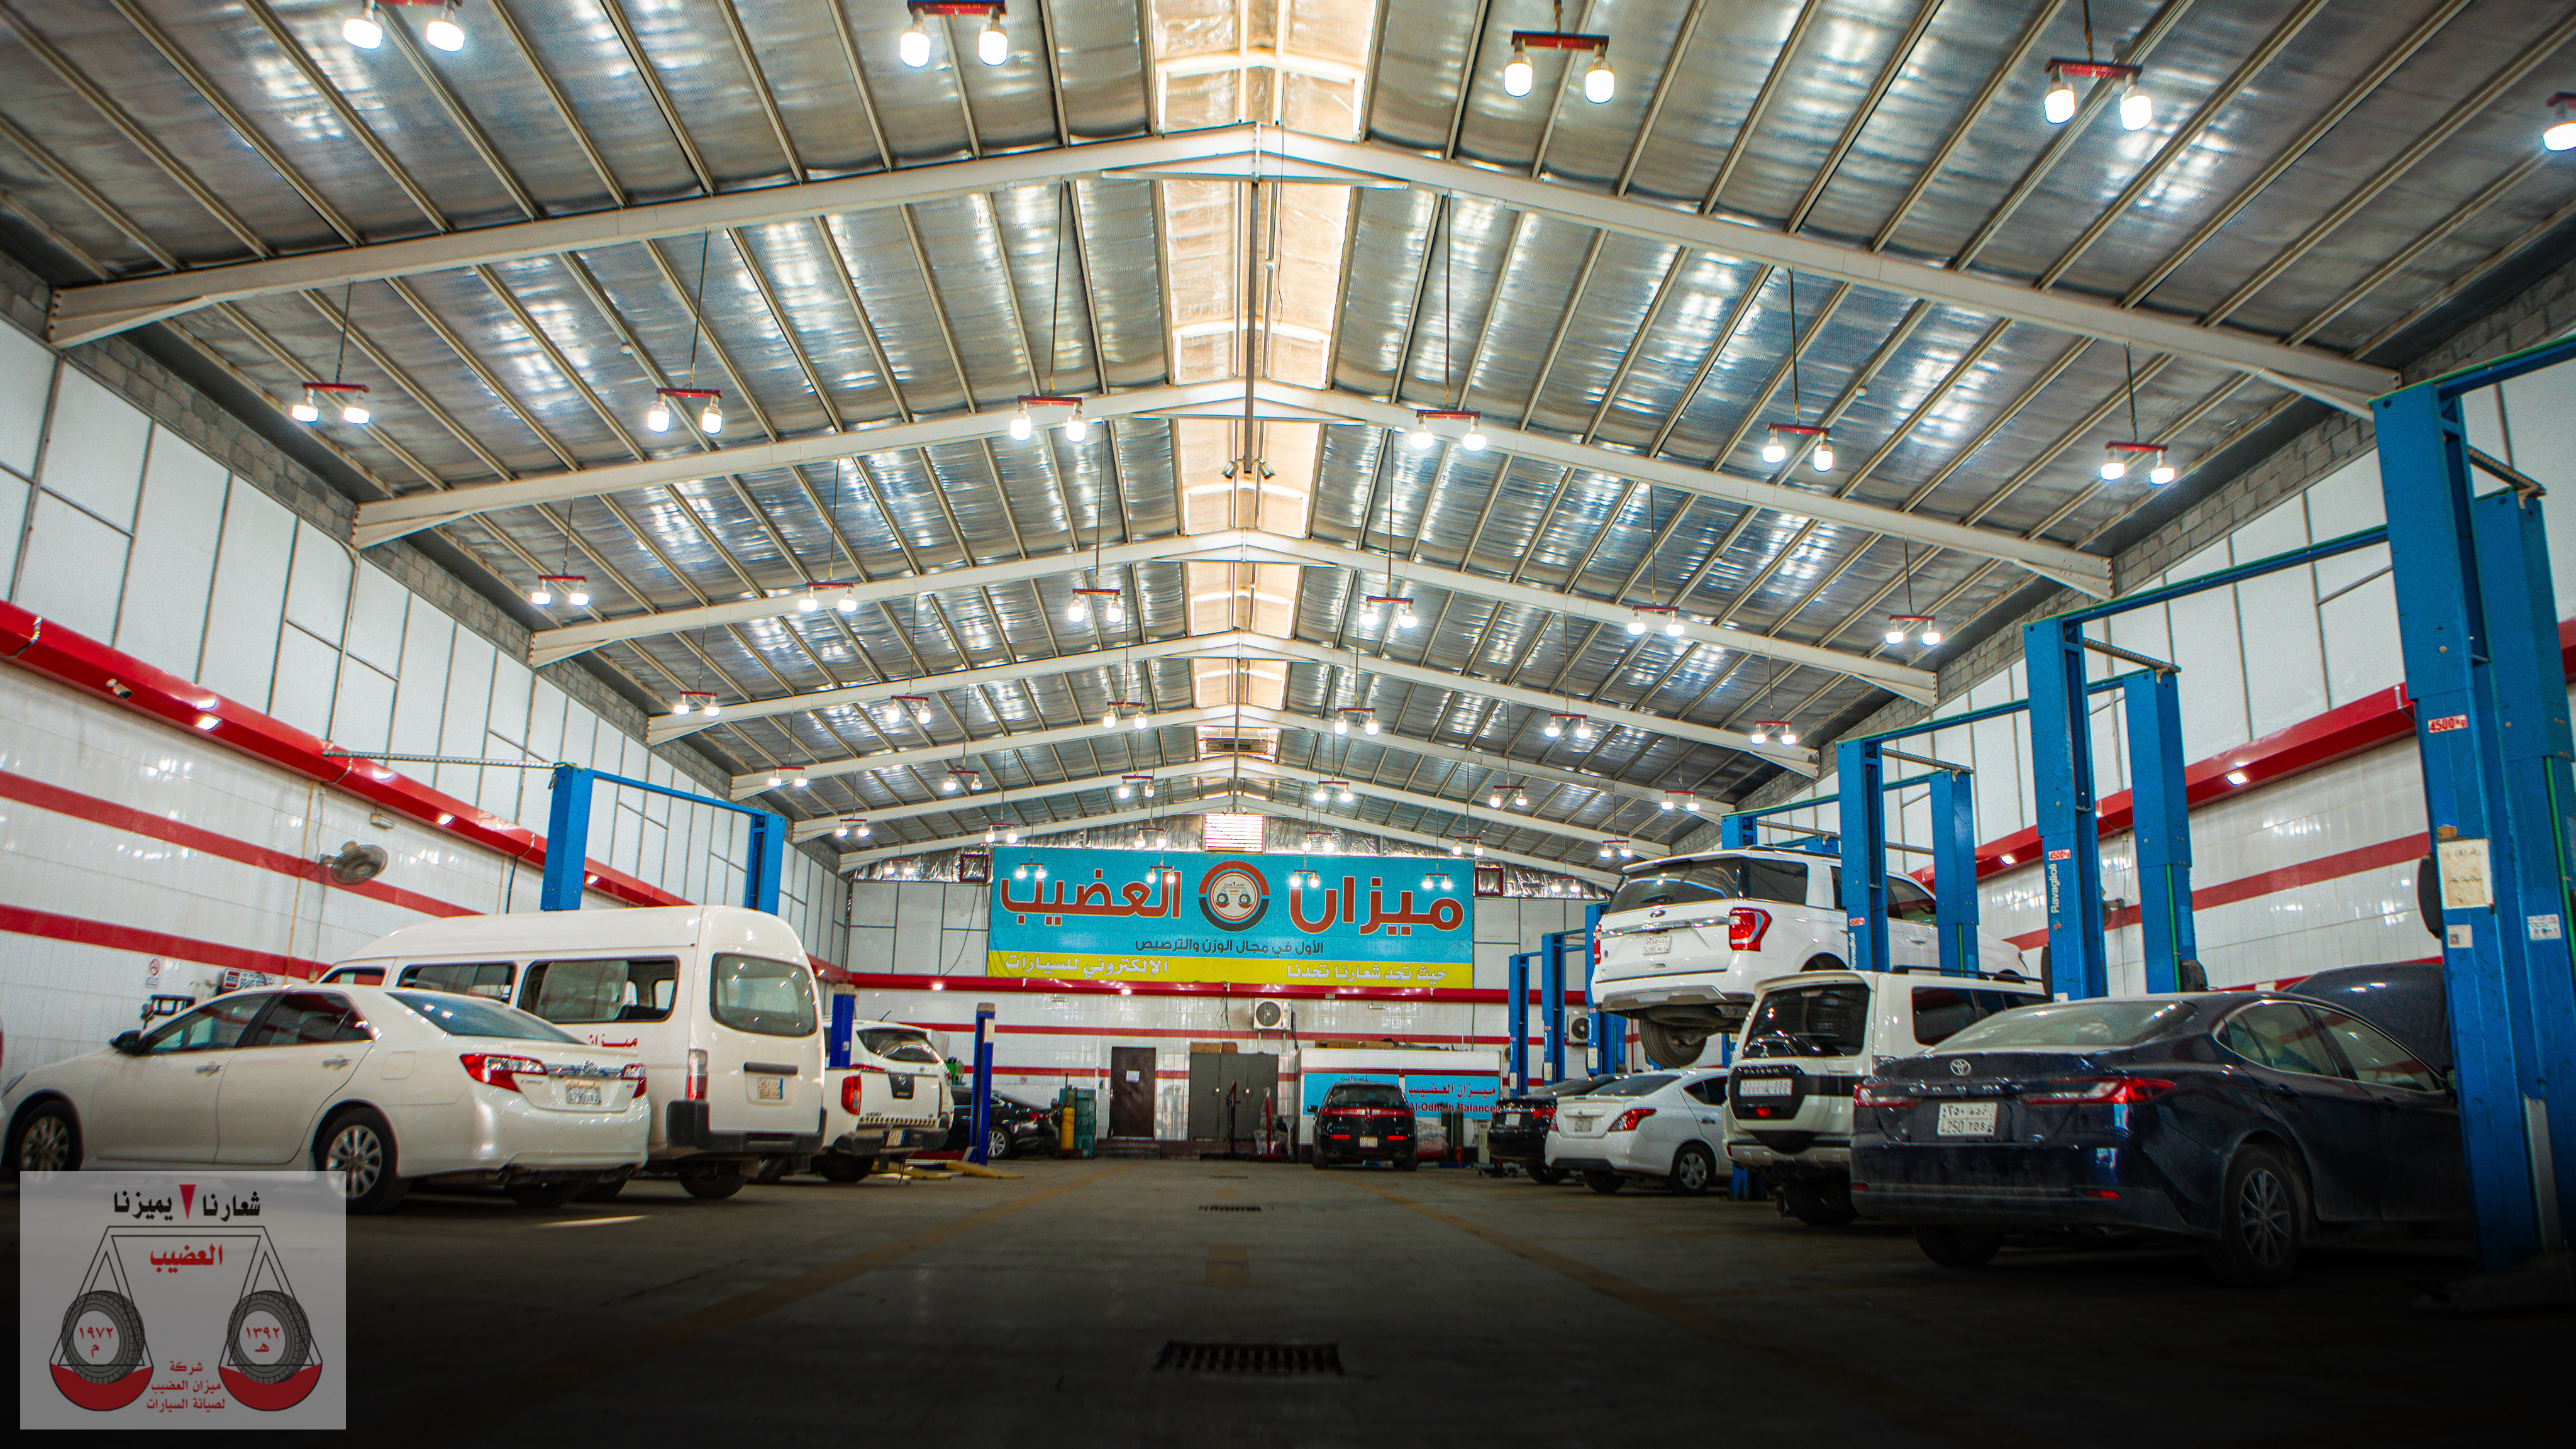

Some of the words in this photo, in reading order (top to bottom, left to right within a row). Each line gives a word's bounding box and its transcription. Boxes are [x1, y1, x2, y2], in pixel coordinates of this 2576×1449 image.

[1001, 869, 1182, 926] العضيب
[1289, 875, 1464, 936] ميزان
[1135, 938, 1201, 953] والترصيص
[1202, 938, 1233, 953] الوزن
[1235, 940, 1269, 954] مجال
[1272, 941, 1292, 958] في
[1295, 940, 1323, 956] الأول
[1006, 954, 1080, 974] للسيارات
[1083, 957, 1168, 979] الإلكتروني
[1287, 963, 1330, 982] تجدنا
[1335, 964, 1380, 982] شعارنا
[1385, 966, 1413, 984] تجد
[1416, 965, 1447, 985] حيث
[1408, 1083, 1454, 1097] العضيب
[1457, 1083, 1496, 1099] ميزان
